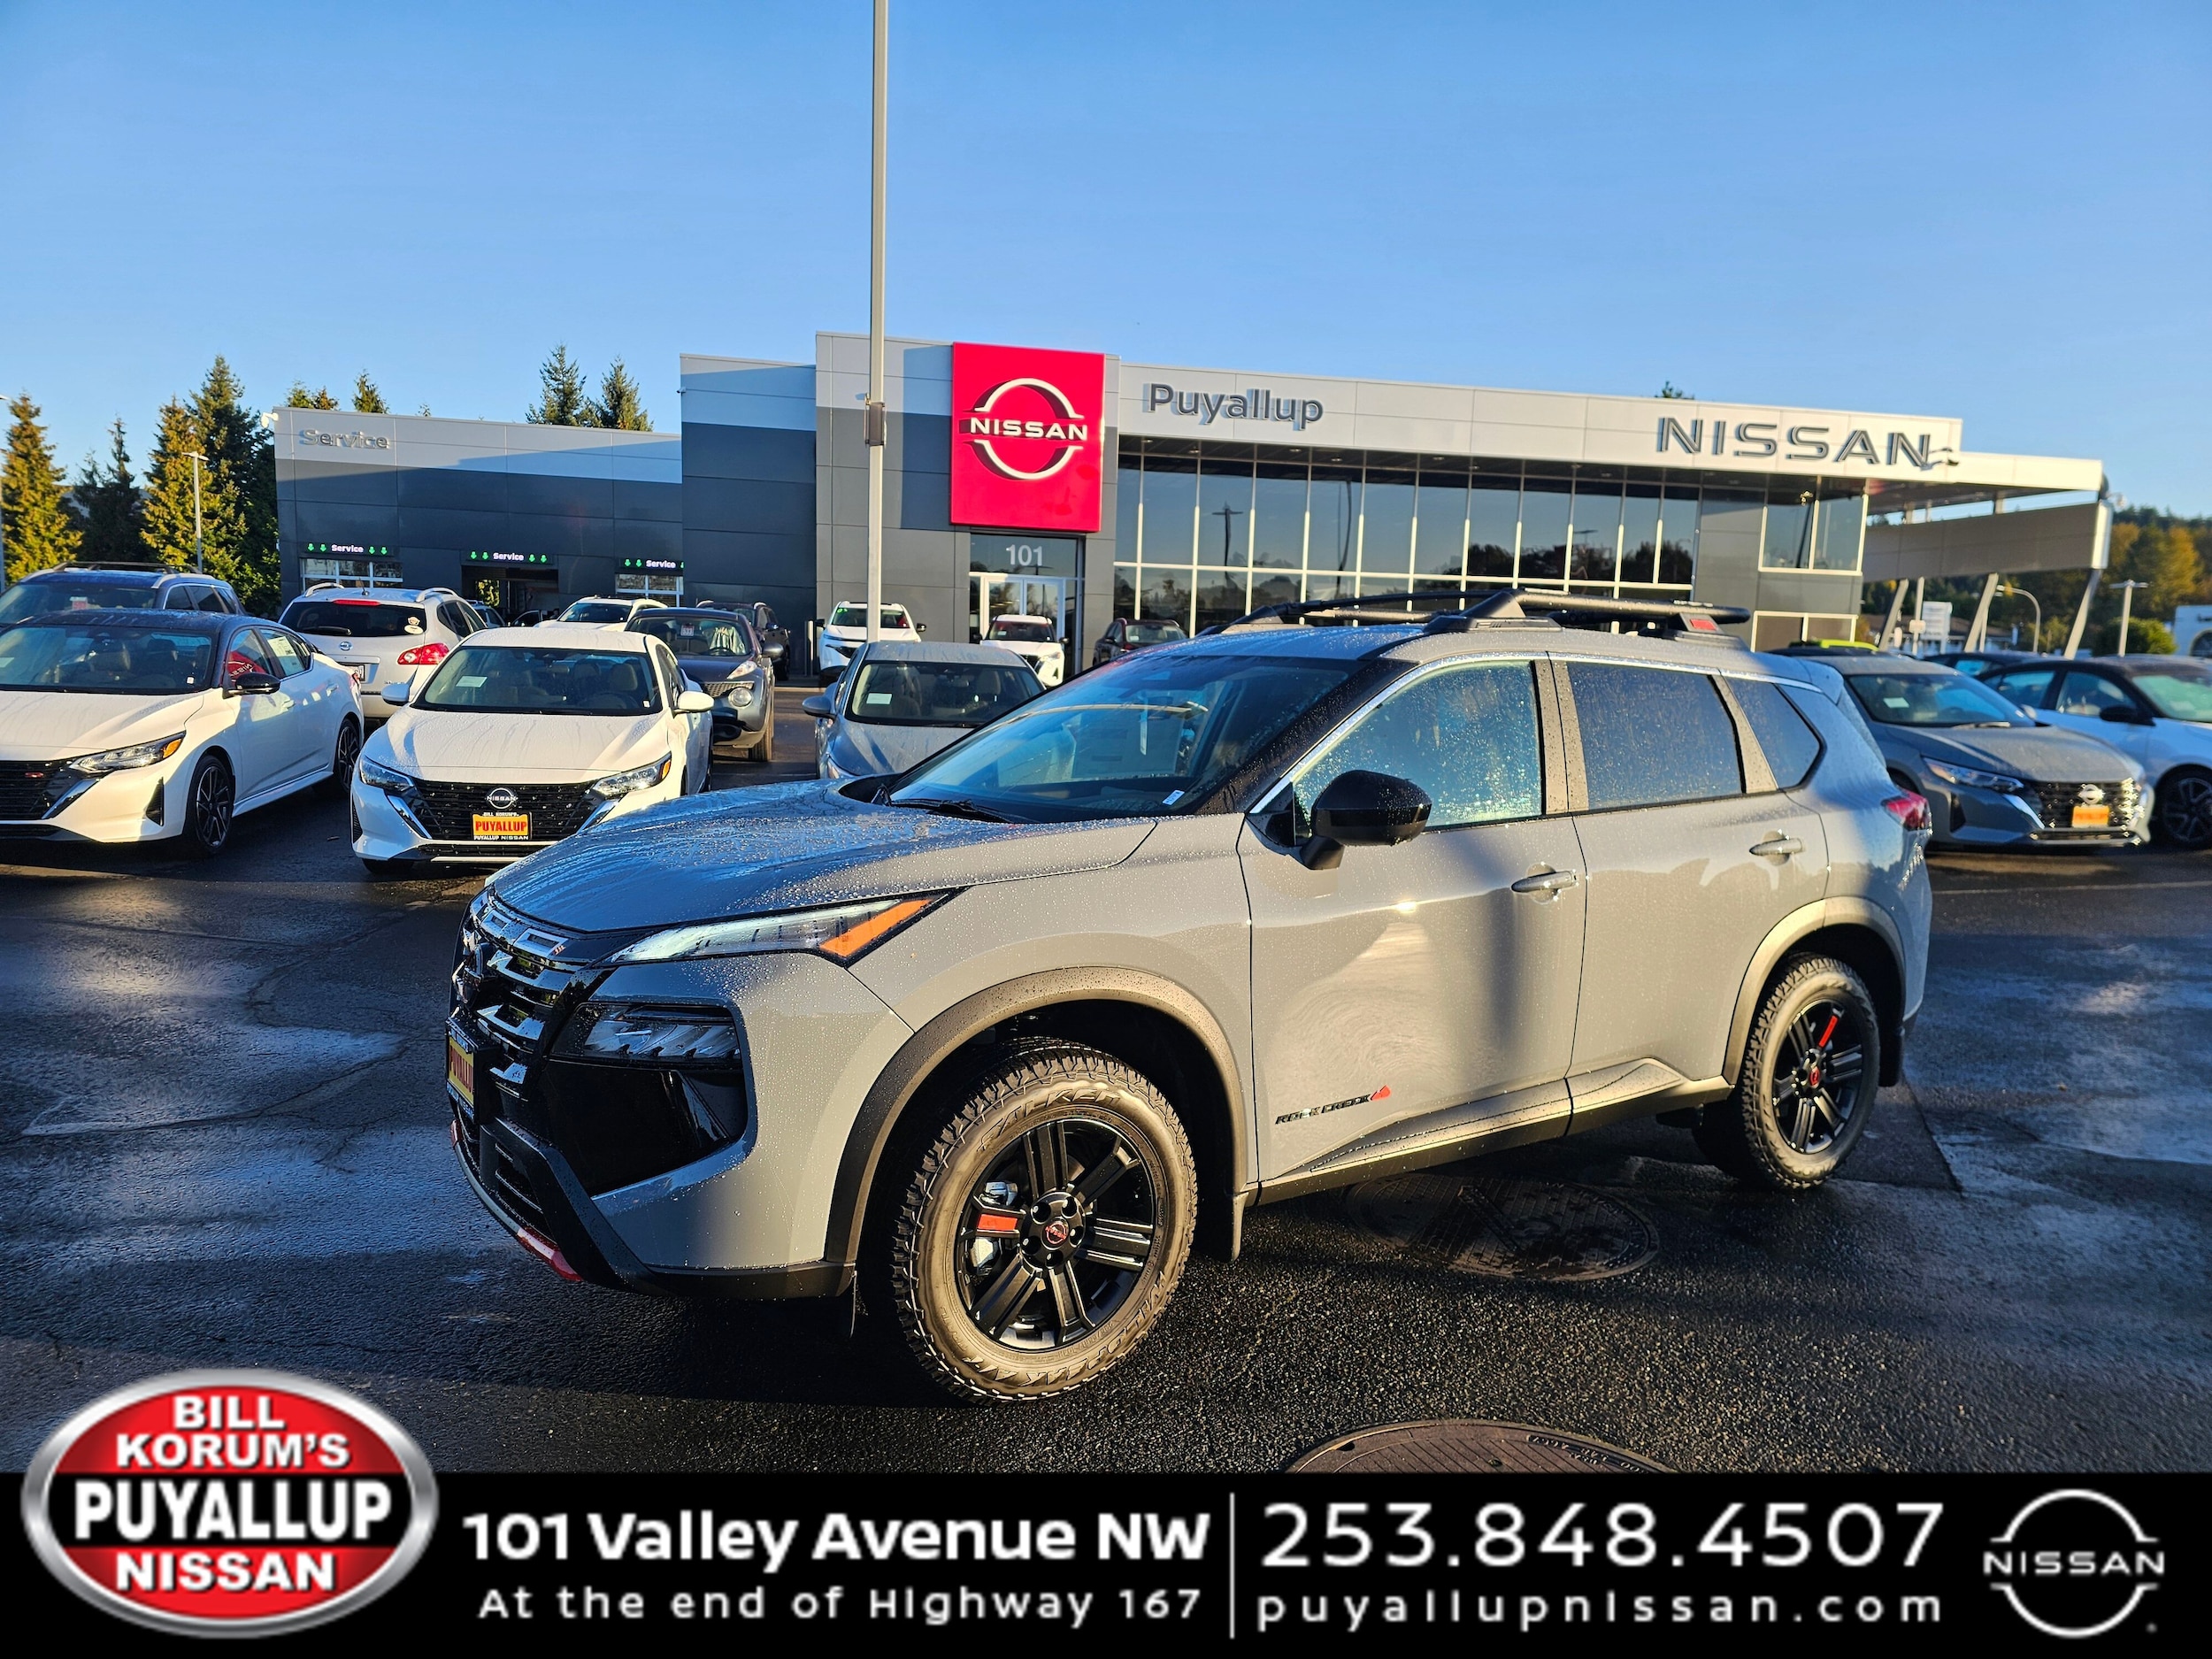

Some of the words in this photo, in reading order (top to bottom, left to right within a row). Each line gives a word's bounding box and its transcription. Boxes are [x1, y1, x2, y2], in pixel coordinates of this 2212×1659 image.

[1149, 383, 1325, 431] Puyallup
[301, 429, 390, 449] Service
[971, 417, 1087, 441] NISSAN
[1658, 418, 1932, 468] NISSAN
[331, 544, 364, 554] Service
[493, 552, 524, 562] Service
[1006, 544, 1043, 566] 101
[646, 559, 676, 569] Service
[475, 820, 527, 832] PUYALLUP
